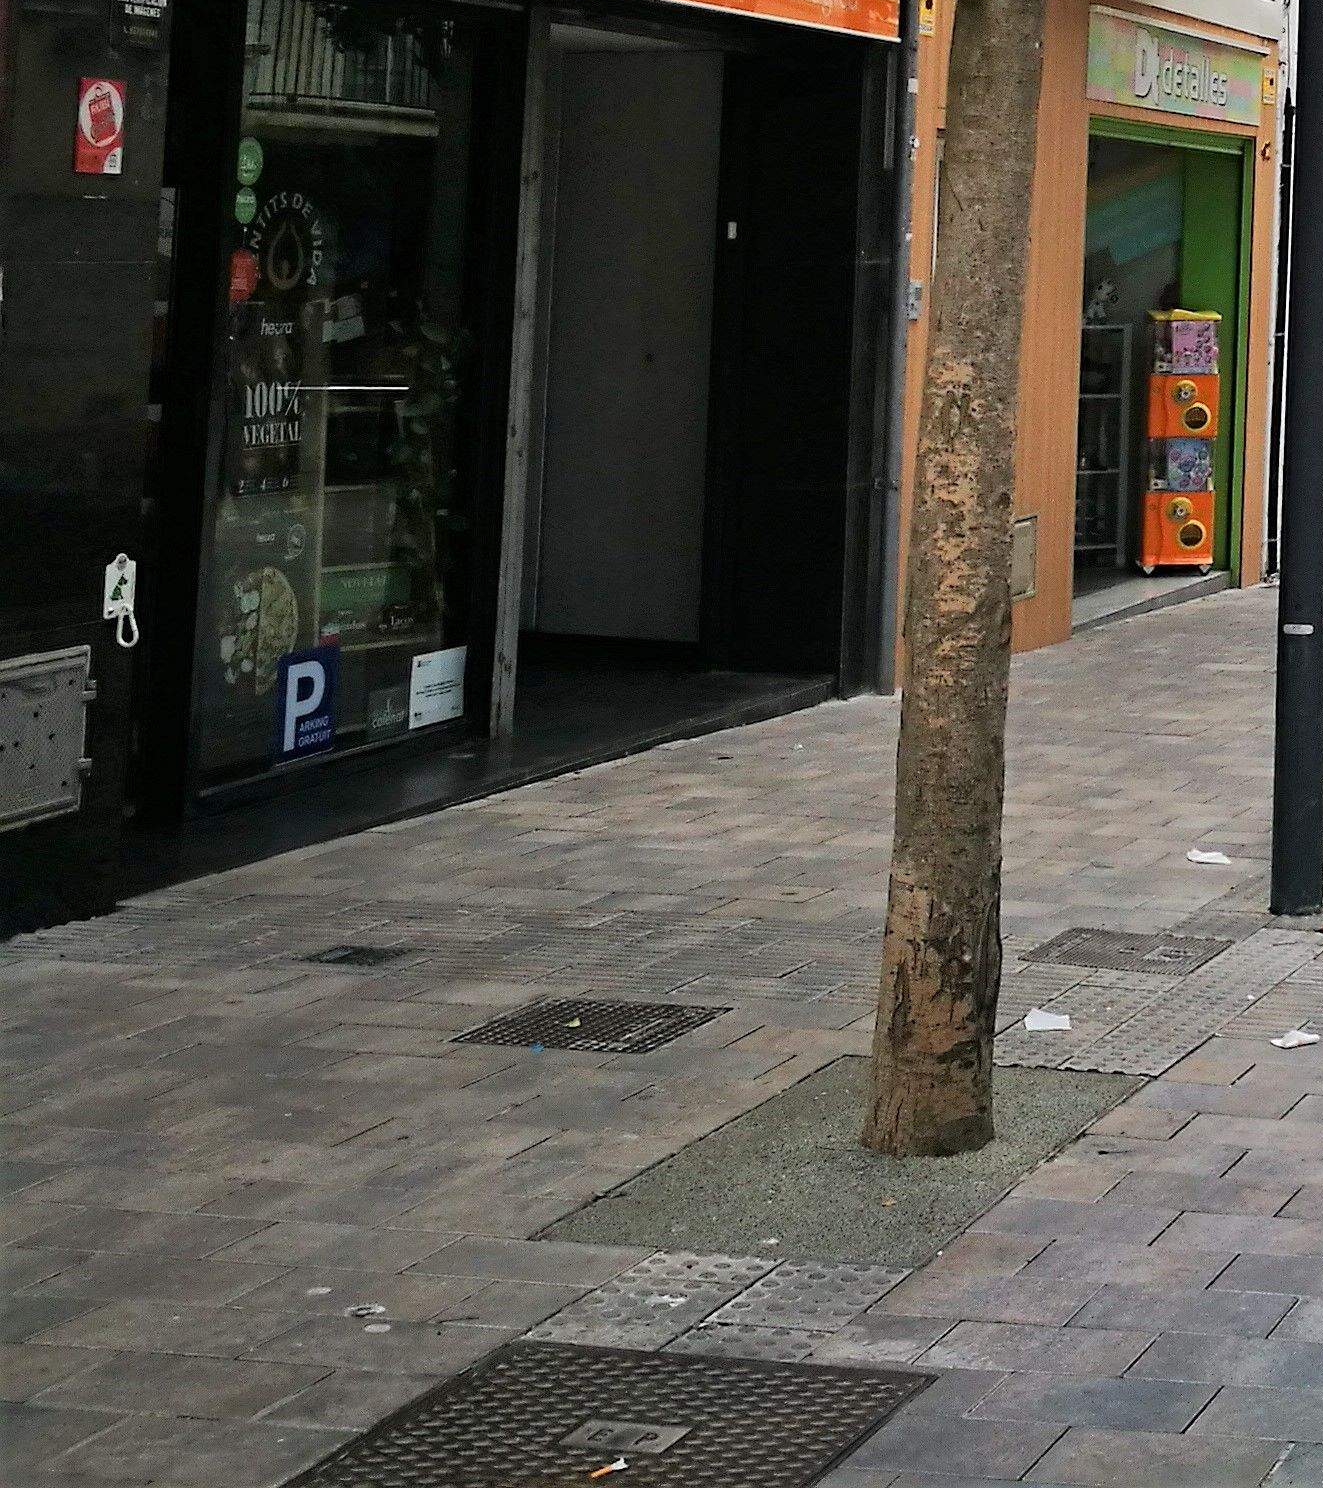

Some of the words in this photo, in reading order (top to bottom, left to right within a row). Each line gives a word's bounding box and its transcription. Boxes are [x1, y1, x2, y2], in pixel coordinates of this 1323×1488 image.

[245, 379, 304, 419] 100%
[243, 420, 302, 445] VEGETAL
[283, 660, 325, 752] P
